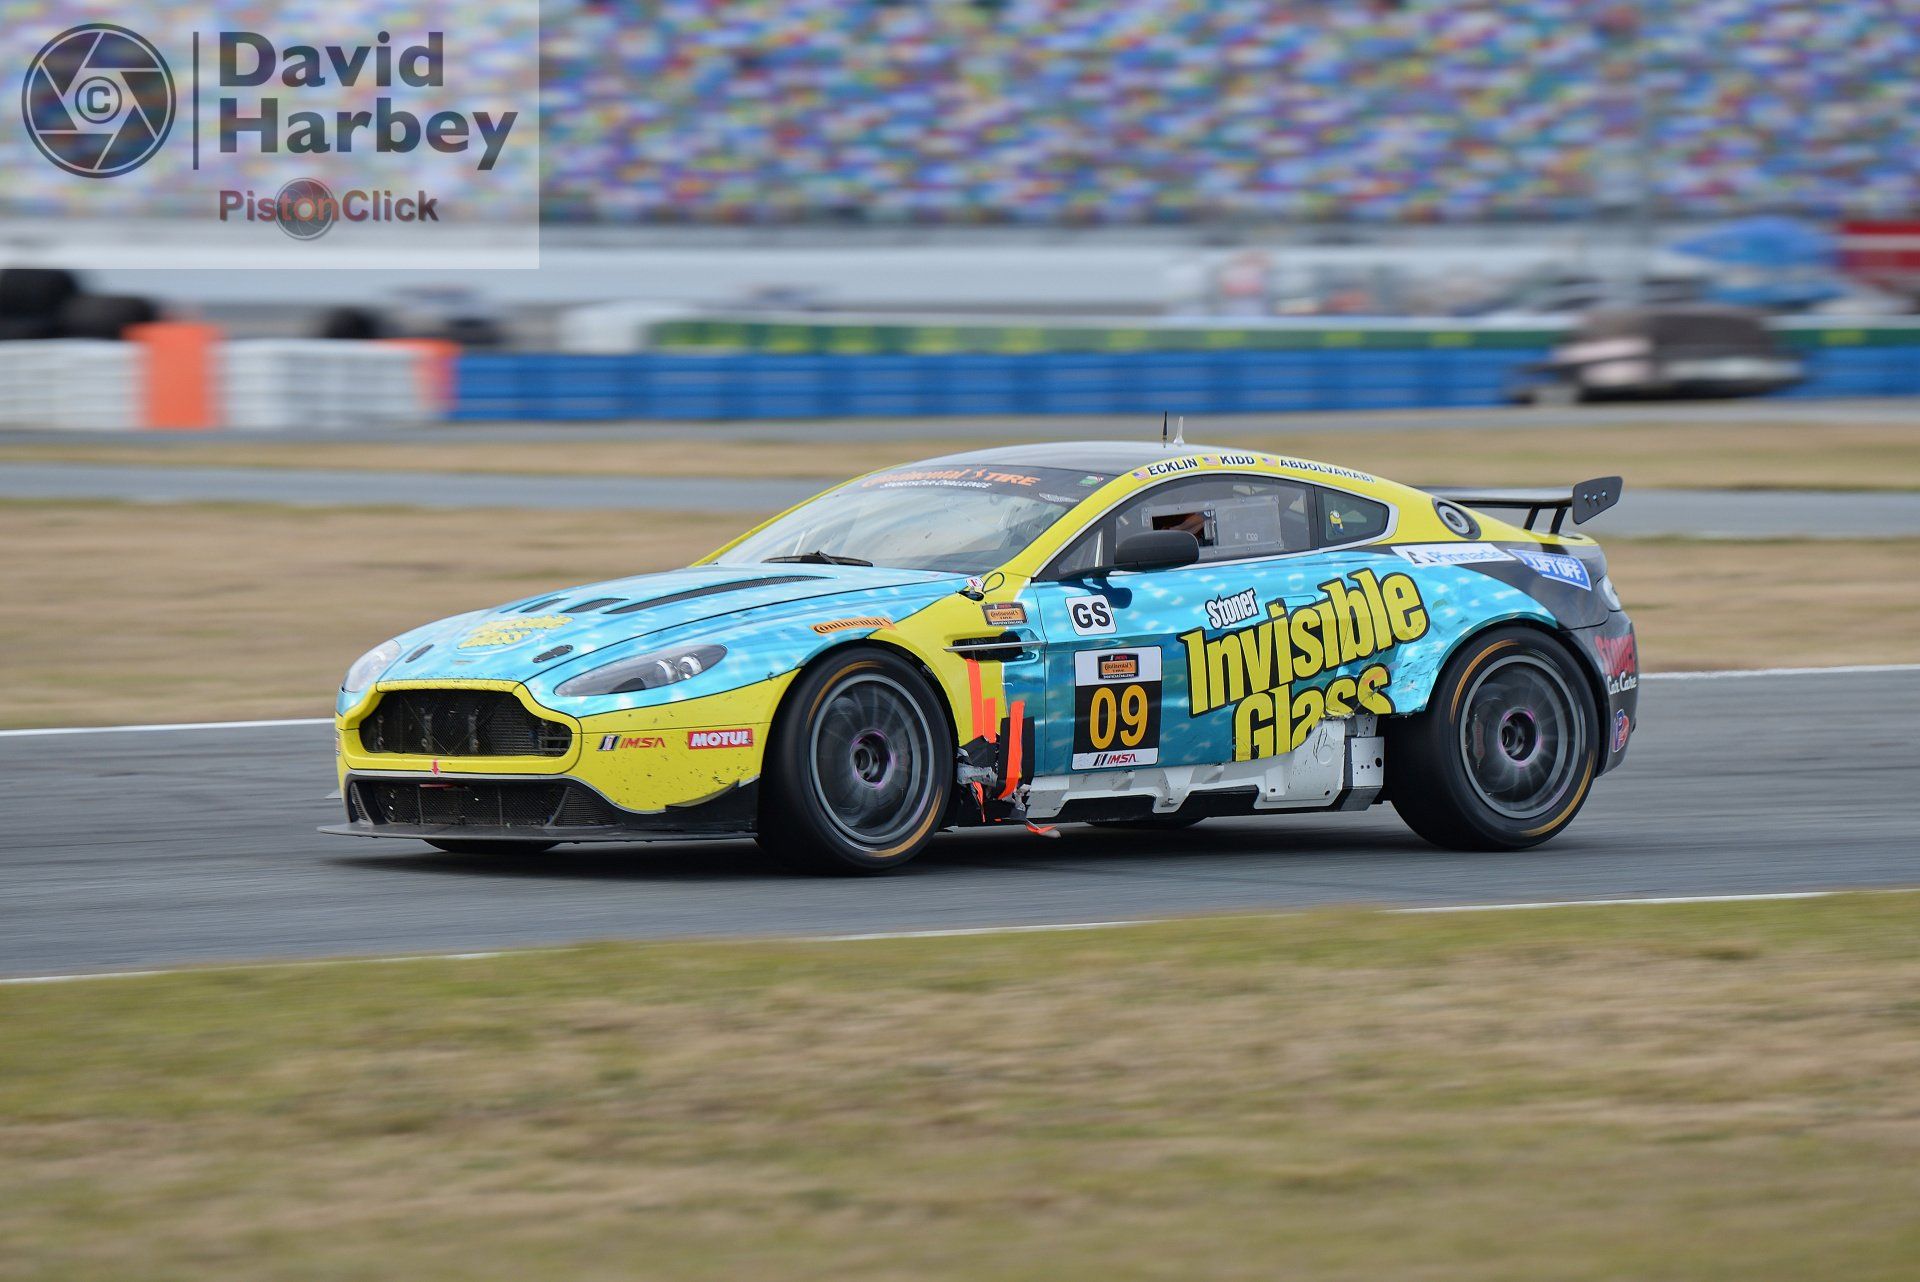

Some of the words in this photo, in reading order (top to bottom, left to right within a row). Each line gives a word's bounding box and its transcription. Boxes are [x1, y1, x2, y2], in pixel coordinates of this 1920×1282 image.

[1148, 457, 1198, 476] ECKLIN
[1220, 455, 1255, 466] KIDD
[985, 471, 1041, 487] TIRE
[1072, 602, 1111, 629] GS
[1205, 588, 1260, 630] Stoner
[814, 617, 883, 634] Continental
[1176, 568, 1430, 719] Invisible
[1607, 675, 1620, 695] Car
[1619, 671, 1637, 692] Care
[1089, 684, 1148, 750] 09
[1232, 663, 1395, 763] Glass
[620, 737, 667, 749] IMSA
[690, 730, 752, 748] MOTUL
[1107, 753, 1138, 765] IMSA
